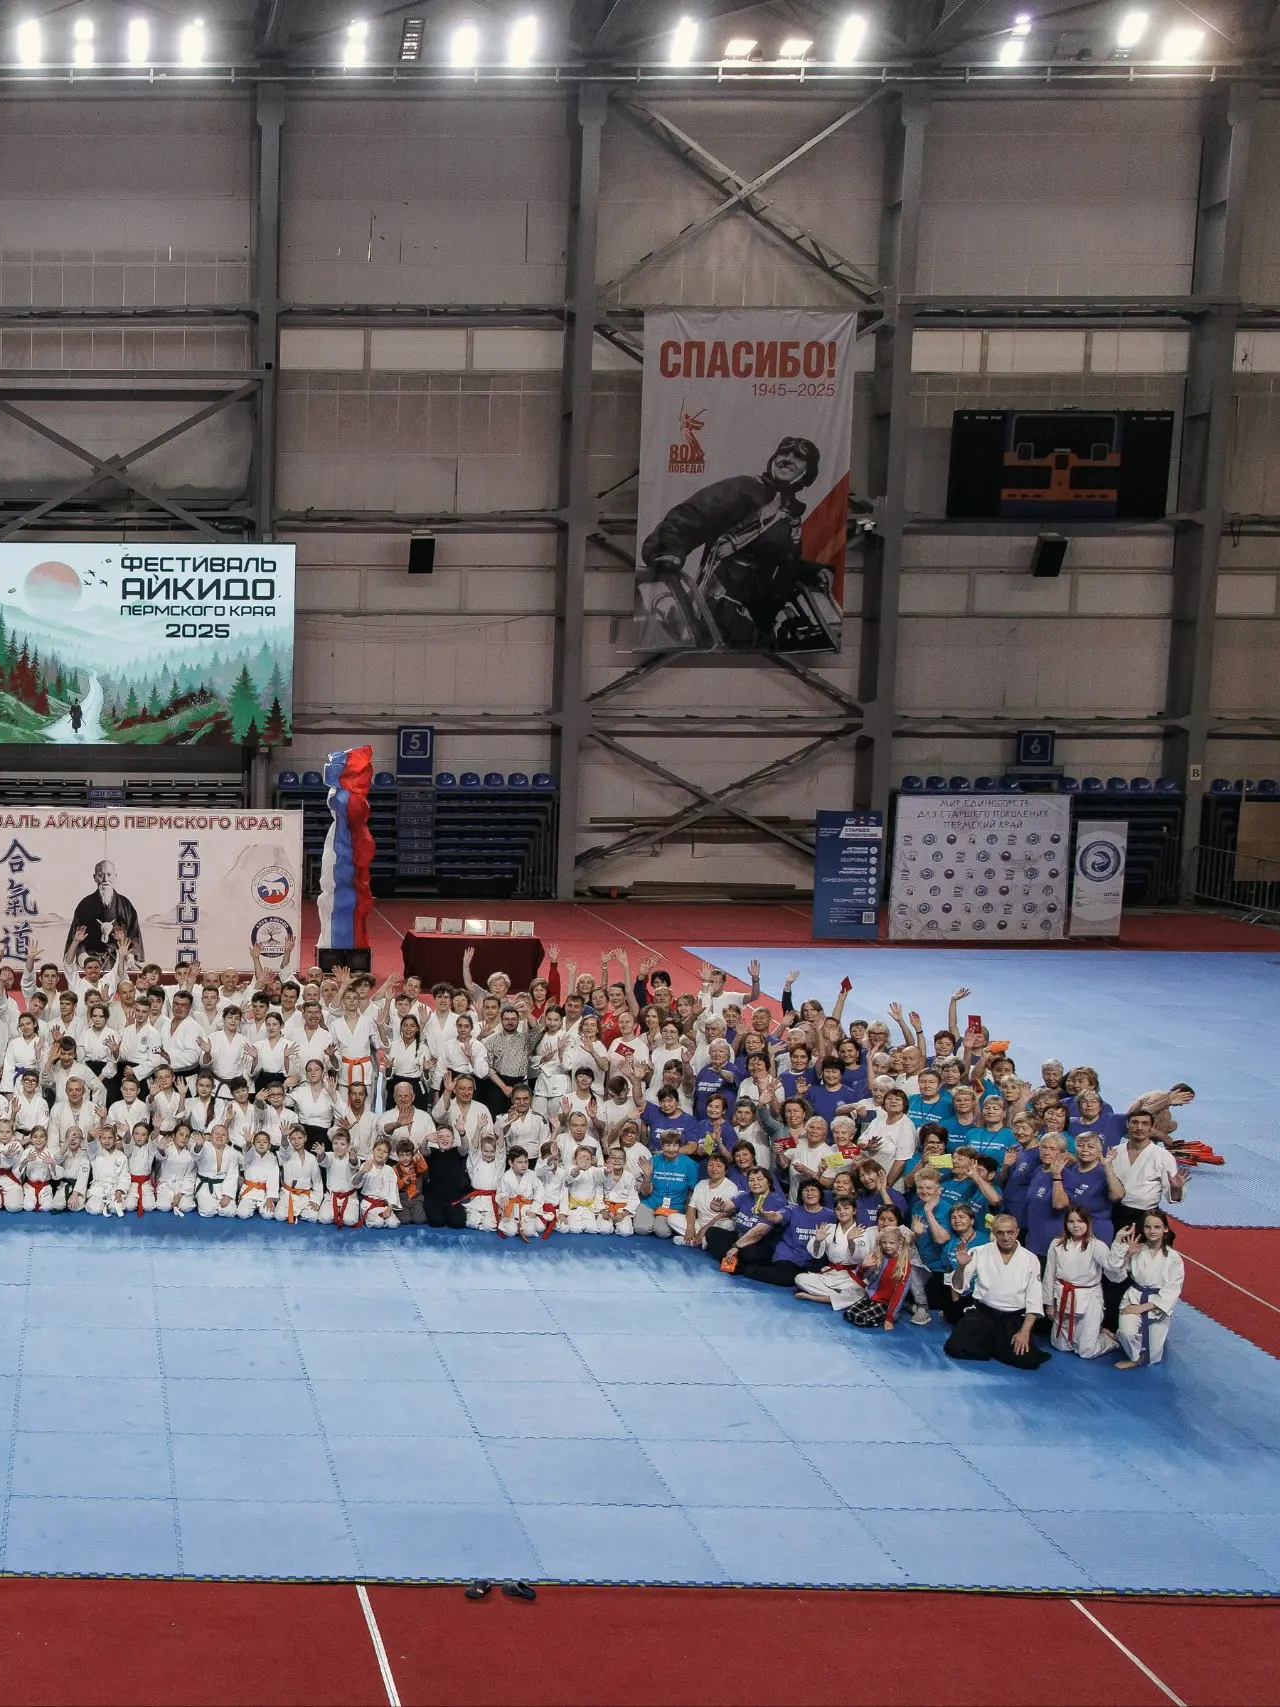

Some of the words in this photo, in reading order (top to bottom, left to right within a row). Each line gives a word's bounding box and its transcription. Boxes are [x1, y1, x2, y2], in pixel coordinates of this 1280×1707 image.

[660, 341, 837, 378] СПАСИБО!
[669, 463, 705, 473] ПОБЕДА!
[121, 556, 277, 572] ФЕСТИВАЛЬ
[122, 575, 275, 601] АЙКИДО
[120, 605, 226, 617] ПЕРМСКОГО
[229, 605, 276, 617] КРАЯ
[165, 623, 230, 639] 2025
[409, 733, 421, 750] 5
[1030, 738, 1041, 754] 6
[44, 811, 120, 831] АЙКИДО
[123, 815, 231, 831] ПЕРМСКОГО
[234, 816, 283, 831] КРАЯ
[940, 810, 991, 818] СТАРШЕГО
[993, 810, 1048, 818] ПОКОЛЕНИЯ
